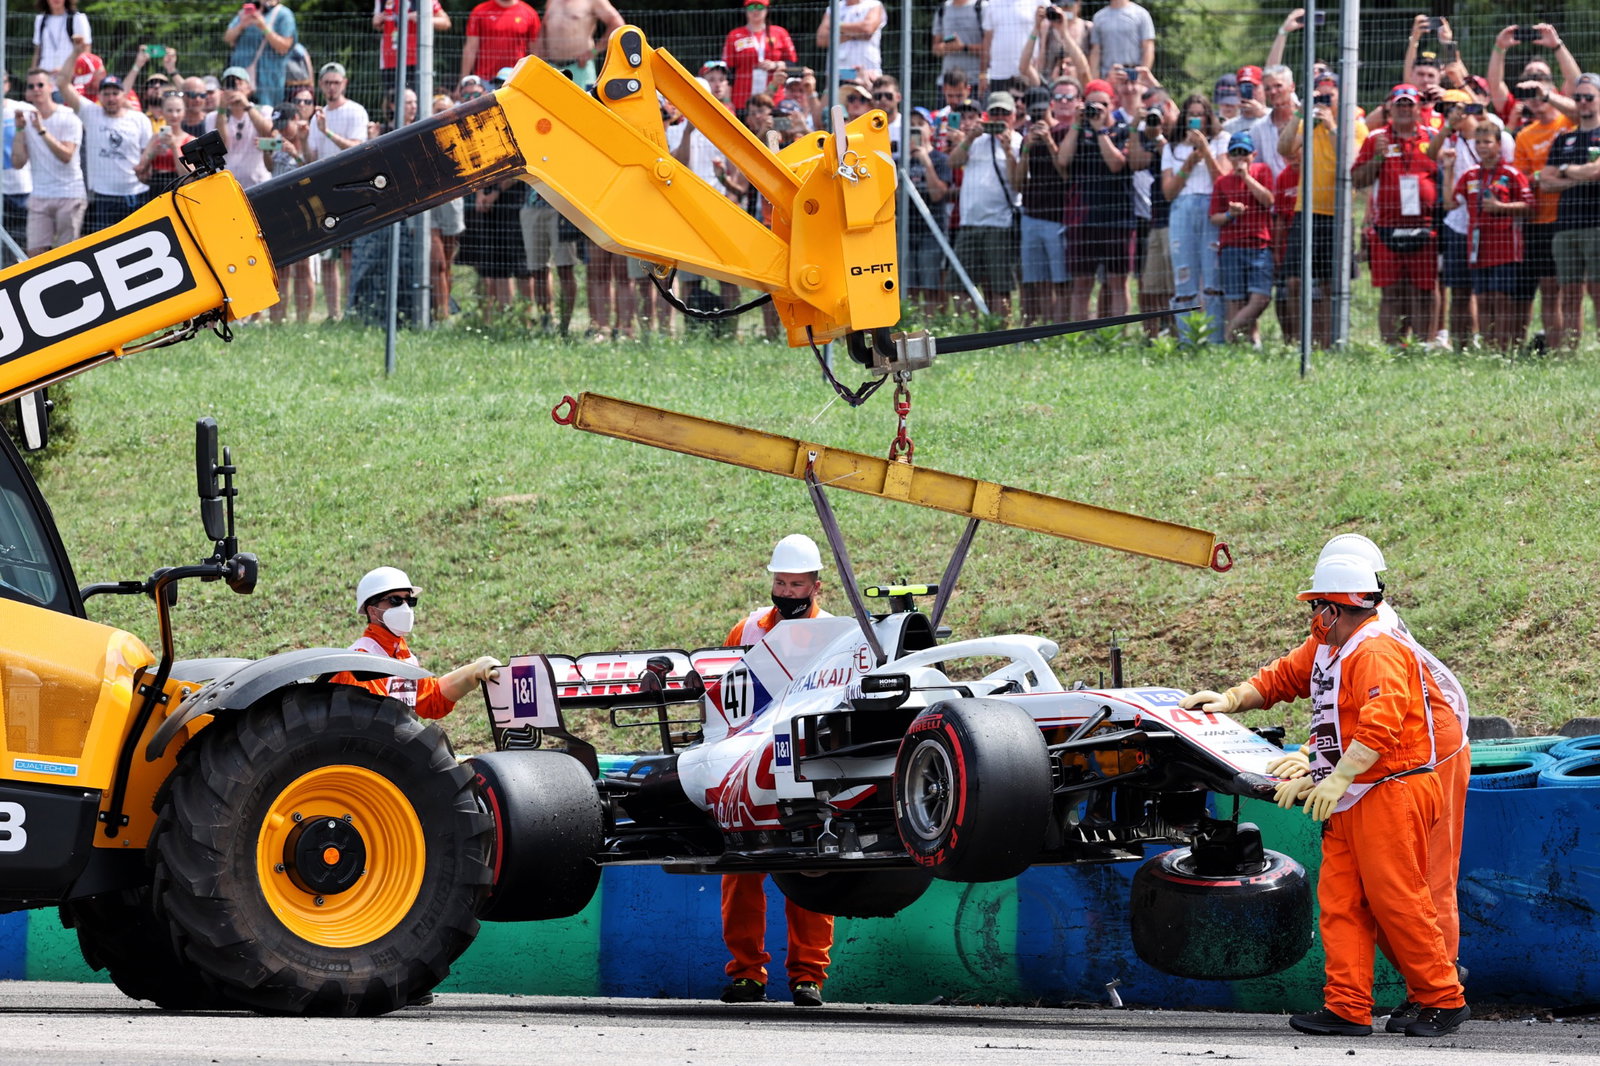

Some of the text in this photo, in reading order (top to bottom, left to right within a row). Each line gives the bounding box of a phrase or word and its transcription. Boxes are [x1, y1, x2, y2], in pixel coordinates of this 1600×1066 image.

[850, 263, 894, 276] Q-FIT
[513, 677, 535, 705] 1&1
[724, 668, 748, 719] 47
[906, 714, 944, 735] PIRELLI
[776, 741, 790, 759] 1&1
[16, 761, 62, 773] DUALTECH
[904, 842, 946, 867] ZERO
